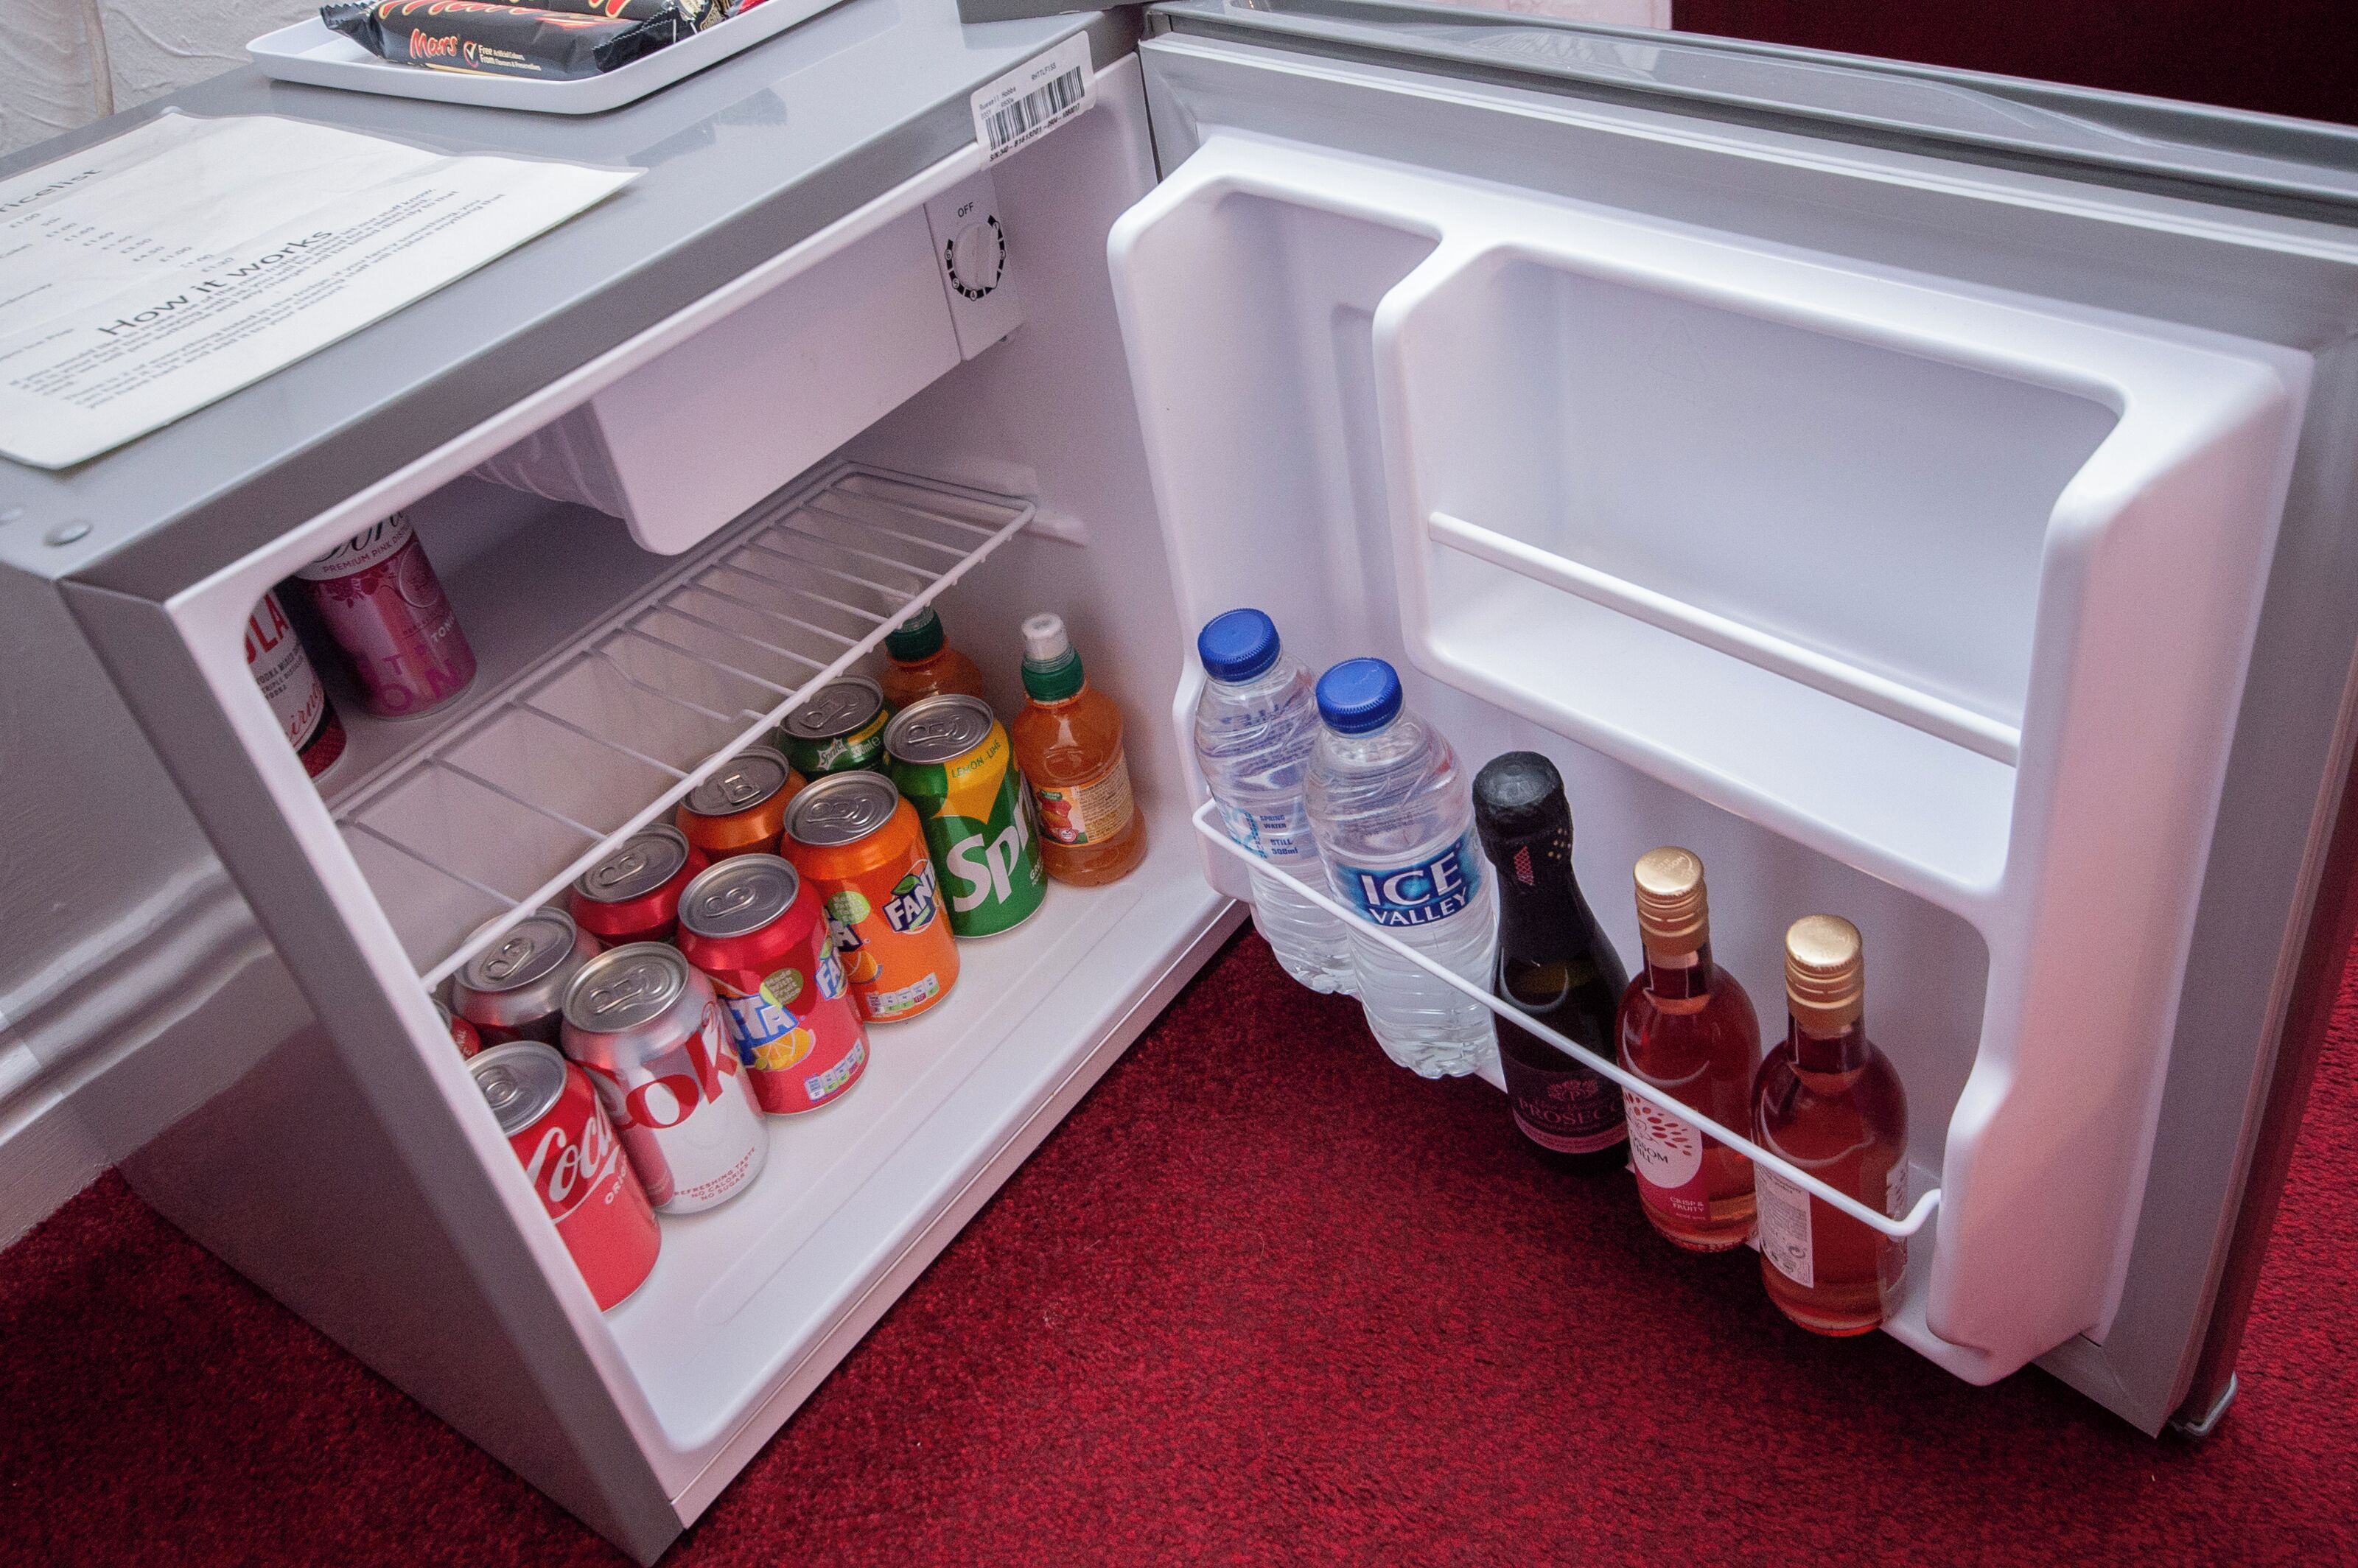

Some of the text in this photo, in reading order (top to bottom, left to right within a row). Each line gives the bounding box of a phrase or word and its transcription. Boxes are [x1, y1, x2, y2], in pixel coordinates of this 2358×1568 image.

[410, 28, 458, 59] Mars
[478, 44, 492, 55] Free
[480, 54, 496, 64] From
[958, 202, 974, 217] OFF
[98, 295, 189, 335] How
[190, 279, 228, 293] it
[226, 231, 333, 278] works
[323, 540, 392, 573] PREMIUM PINK
[1361, 852, 1463, 906] ICE
[1369, 886, 1467, 925] VALLEY
[674, 1147, 755, 1197] REFRESHING TASTE
[691, 1163, 749, 1199] NO CALORIES
[700, 1172, 746, 1201] NO SUGAR
[1670, 1197, 1696, 1205] CRISP
[1673, 1203, 1704, 1213] FRUITY
